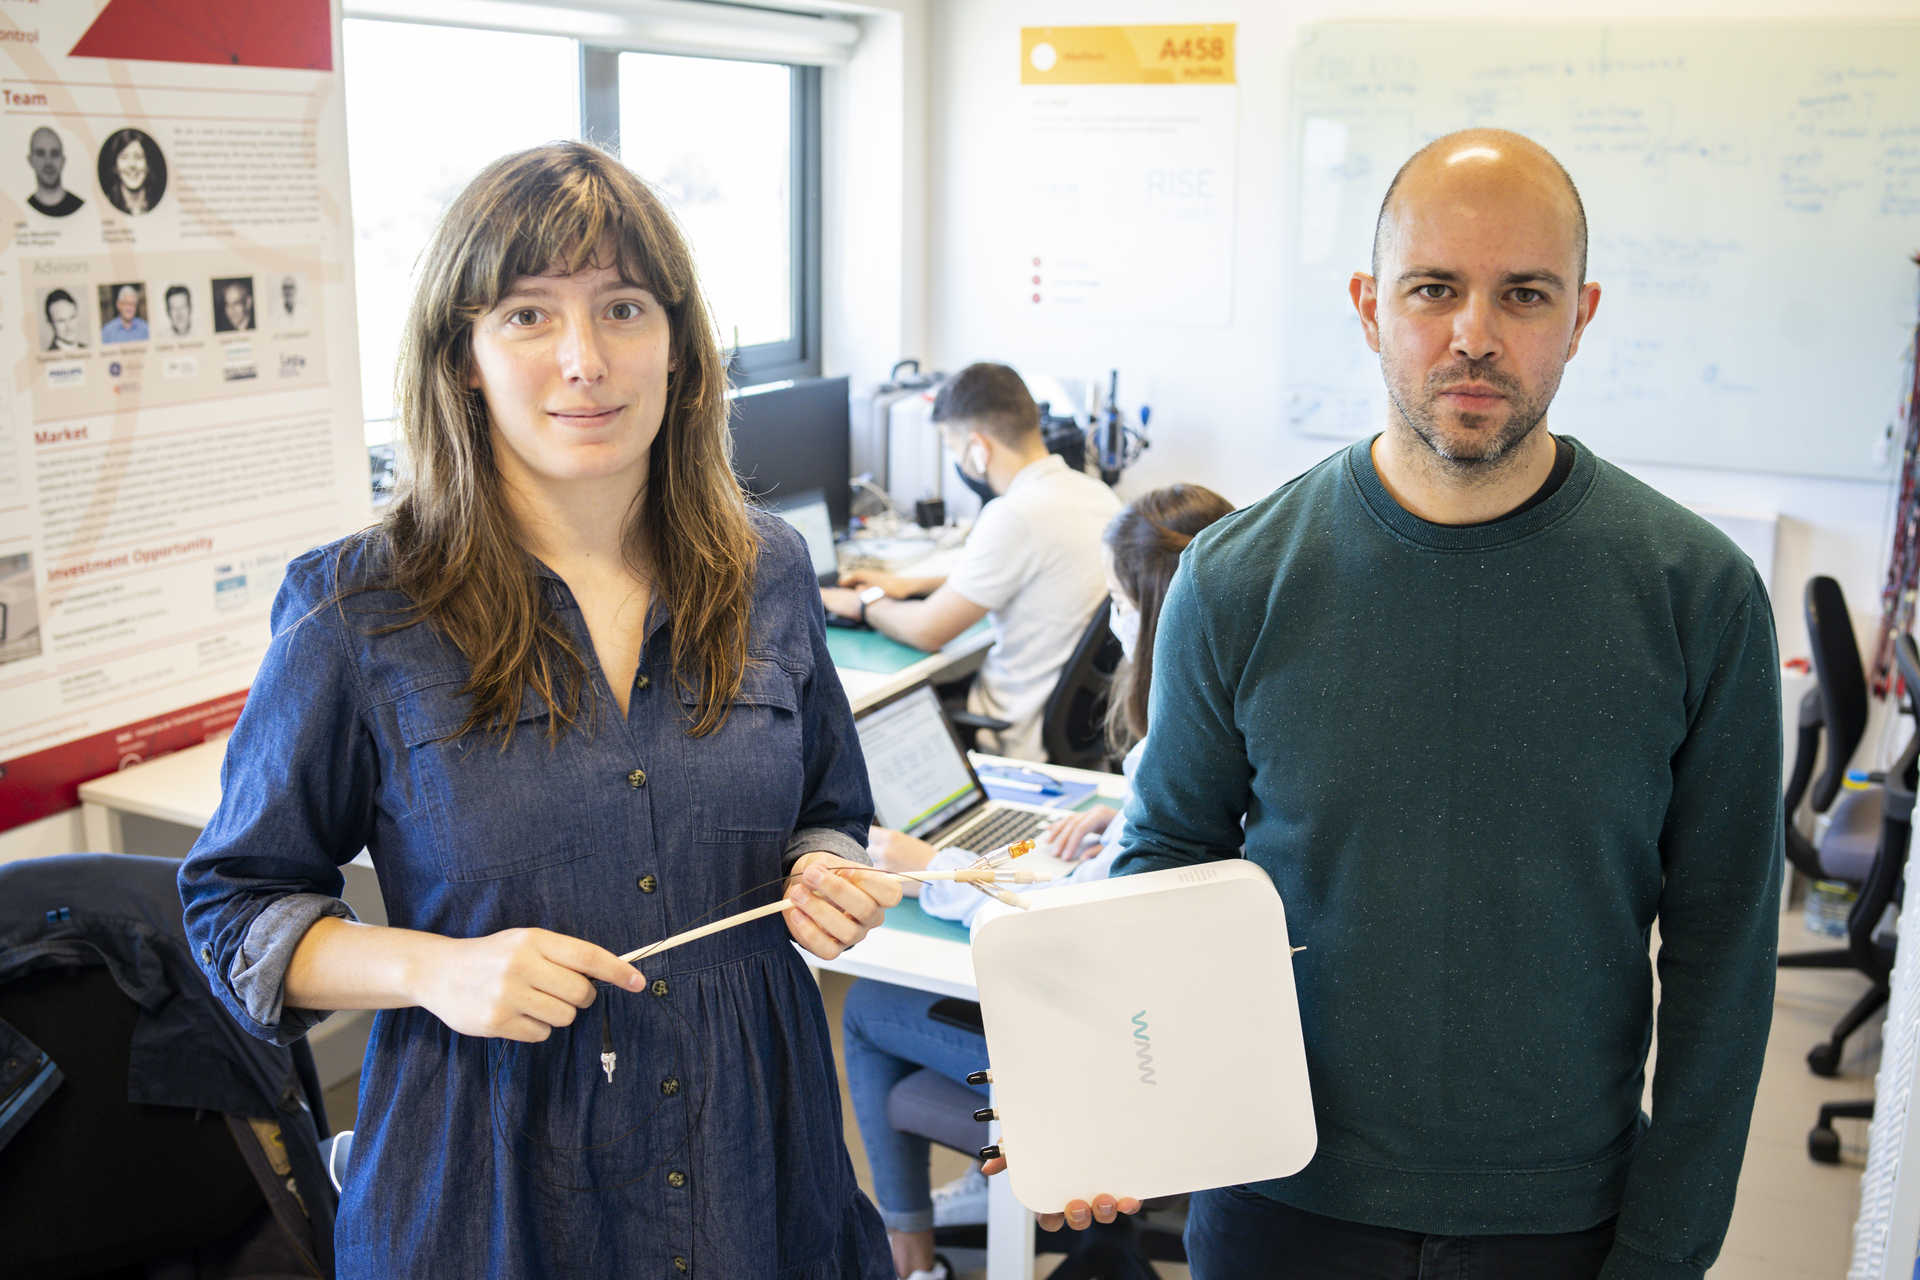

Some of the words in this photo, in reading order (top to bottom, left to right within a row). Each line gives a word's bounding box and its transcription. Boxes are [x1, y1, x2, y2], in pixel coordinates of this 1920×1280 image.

[1160, 36, 1225, 62] A458
[3, 89, 48, 106] Team
[1147, 170, 1213, 198] RISE
[34, 426, 88, 446] Market
[47, 554, 129, 582] Investment
[132, 537, 214, 564] Opportunity
